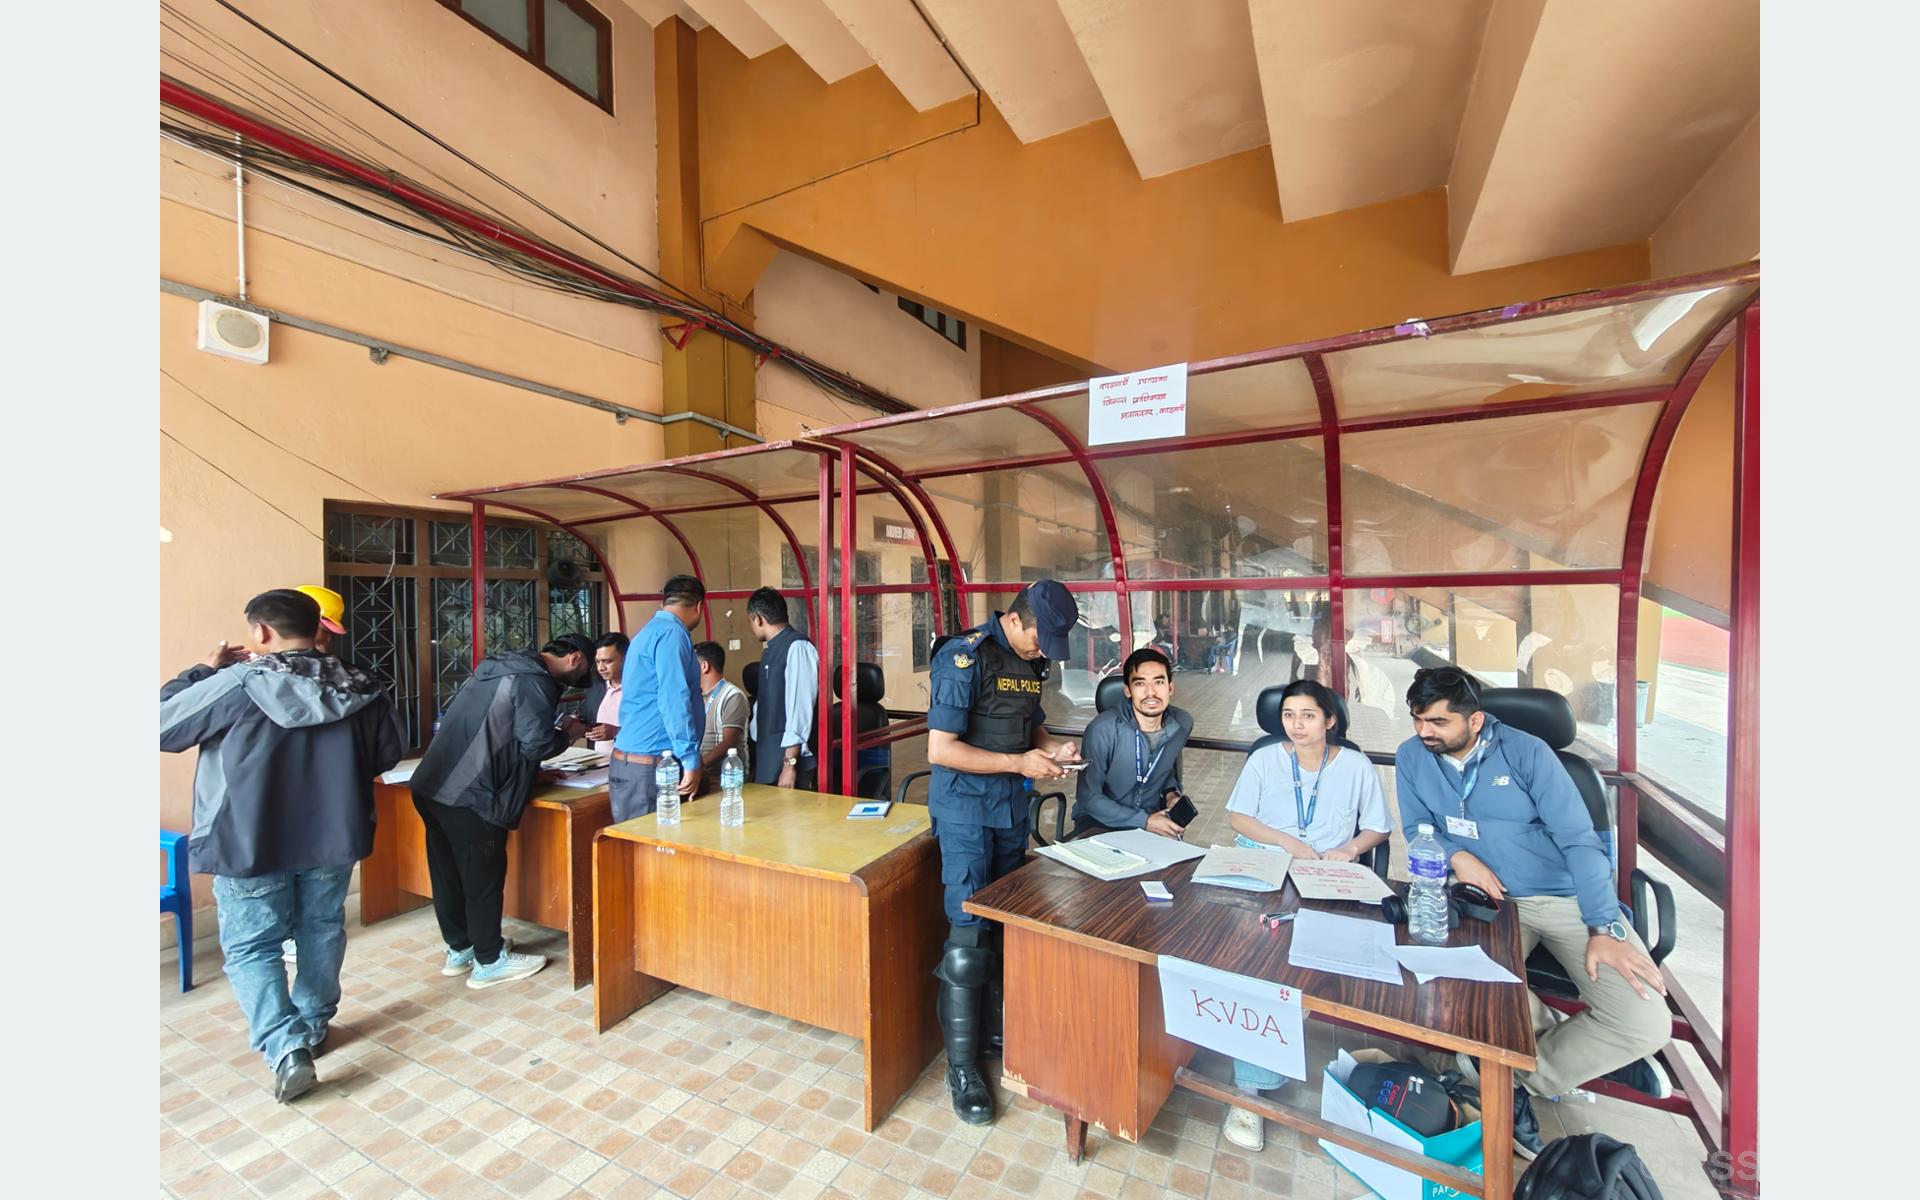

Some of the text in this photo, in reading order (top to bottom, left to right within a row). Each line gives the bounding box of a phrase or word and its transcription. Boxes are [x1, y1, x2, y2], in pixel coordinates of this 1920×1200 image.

[997, 677, 1041, 693] NEPAL POLICE
[1190, 989, 1288, 1045] KVDA
[1377, 1080, 1394, 1105] EOS
